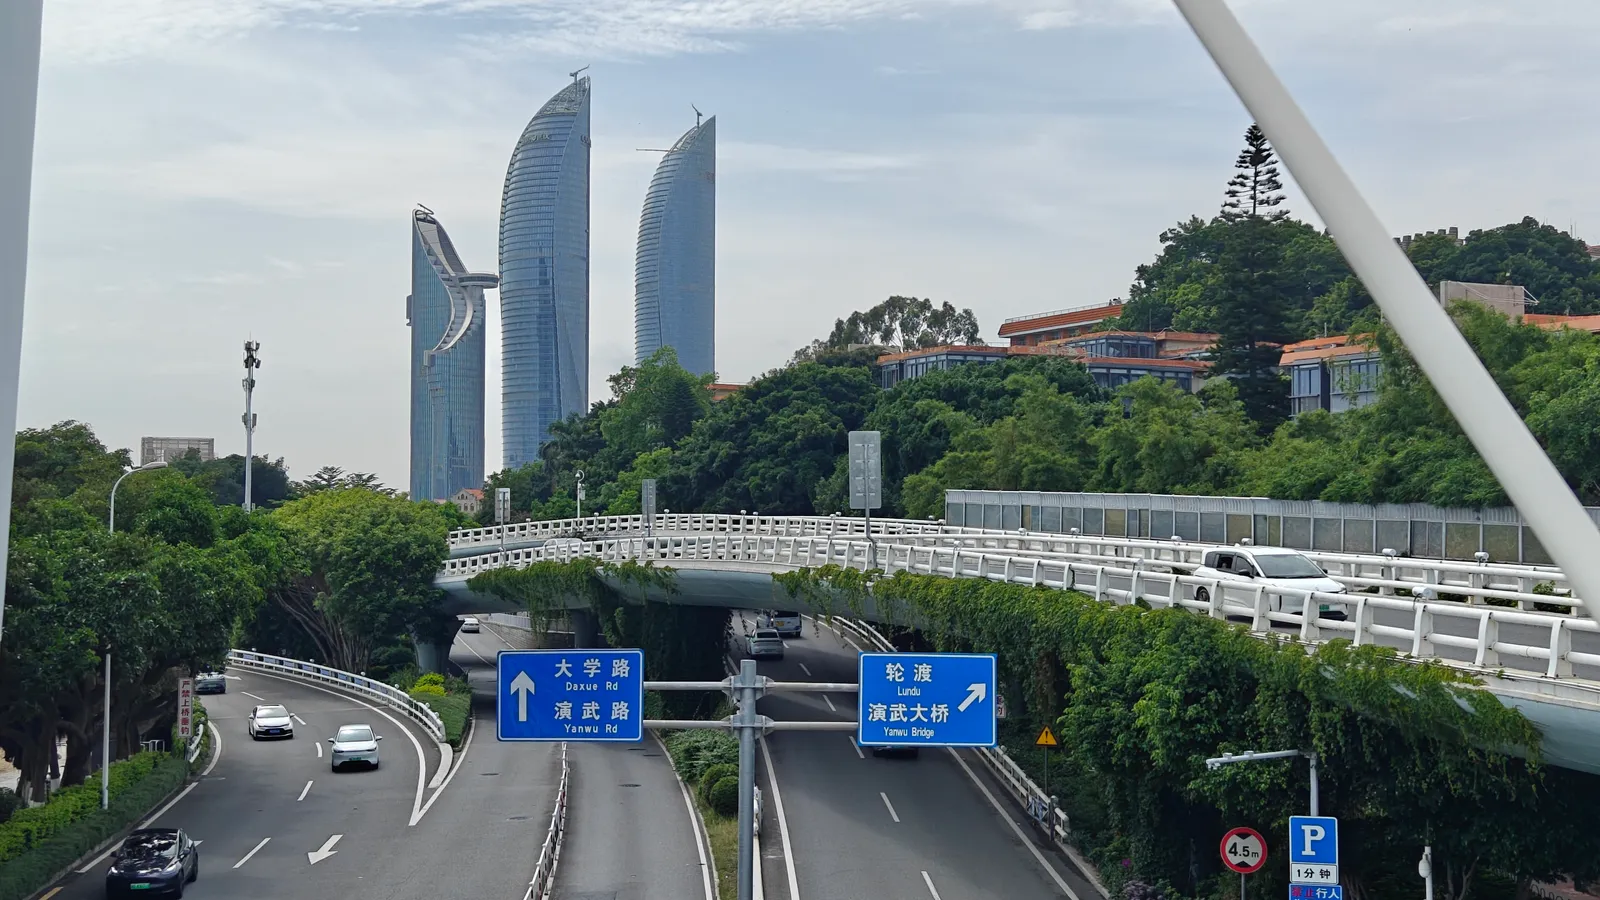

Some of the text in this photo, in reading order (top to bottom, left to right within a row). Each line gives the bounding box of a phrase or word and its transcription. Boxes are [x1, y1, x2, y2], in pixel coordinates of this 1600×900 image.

[554, 658, 630, 678] 大学路
[885, 662, 932, 682] 轮渡
[566, 681, 618, 691] Daxue Rd
[897, 686, 921, 696] Lundu
[554, 701, 630, 720] 演武路
[868, 703, 949, 723] 演武大桥
[564, 723, 618, 733] Yanwu Rd
[883, 726, 935, 739] Yanwu Bridge
[1301, 824, 1326, 856] P
[1297, 868, 1331, 880] 1分钟
